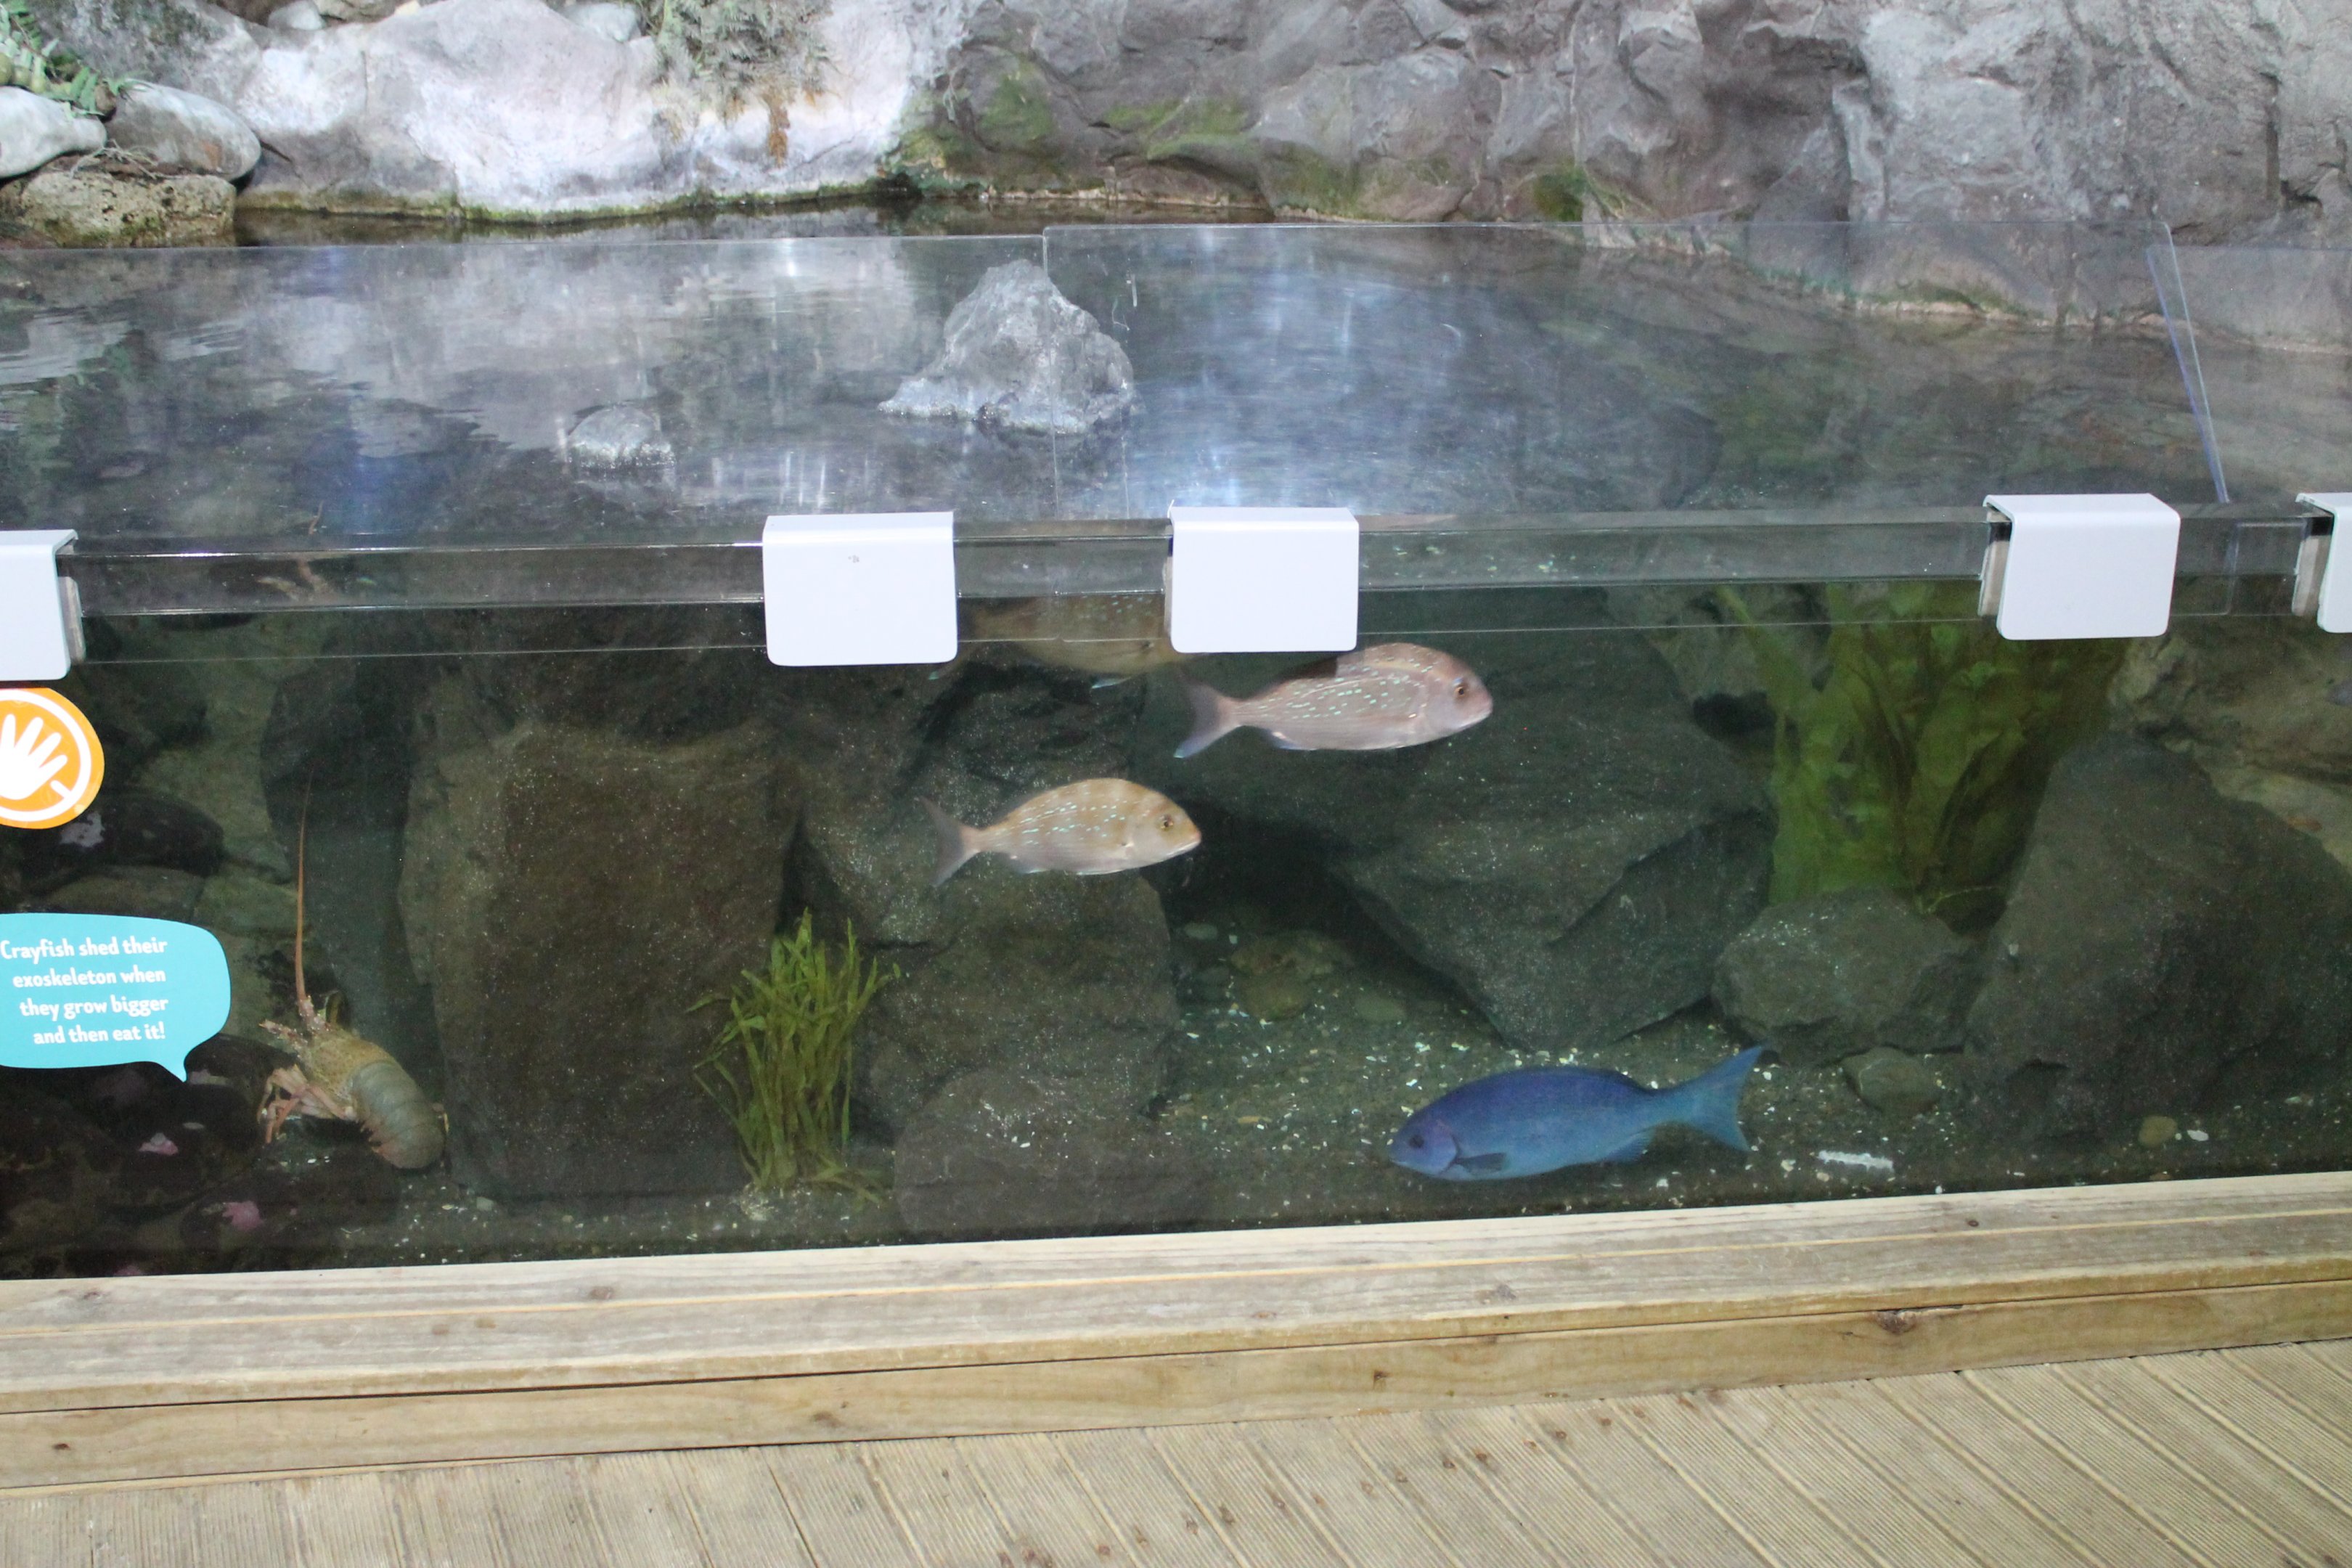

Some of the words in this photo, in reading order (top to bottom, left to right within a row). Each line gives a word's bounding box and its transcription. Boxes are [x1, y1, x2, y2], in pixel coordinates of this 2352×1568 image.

[0, 939, 74, 964] Crayfish
[79, 936, 119, 955] shed
[123, 936, 167, 953] their
[12, 967, 116, 987] exoskeleton
[120, 965, 166, 983] when
[20, 998, 59, 1021] they
[64, 1001, 107, 1020] grow
[110, 995, 168, 1016] bigger
[33, 1026, 65, 1044] and
[68, 1025, 108, 1042] then
[113, 1026, 142, 1041] eat
[144, 1021, 166, 1039] it!
